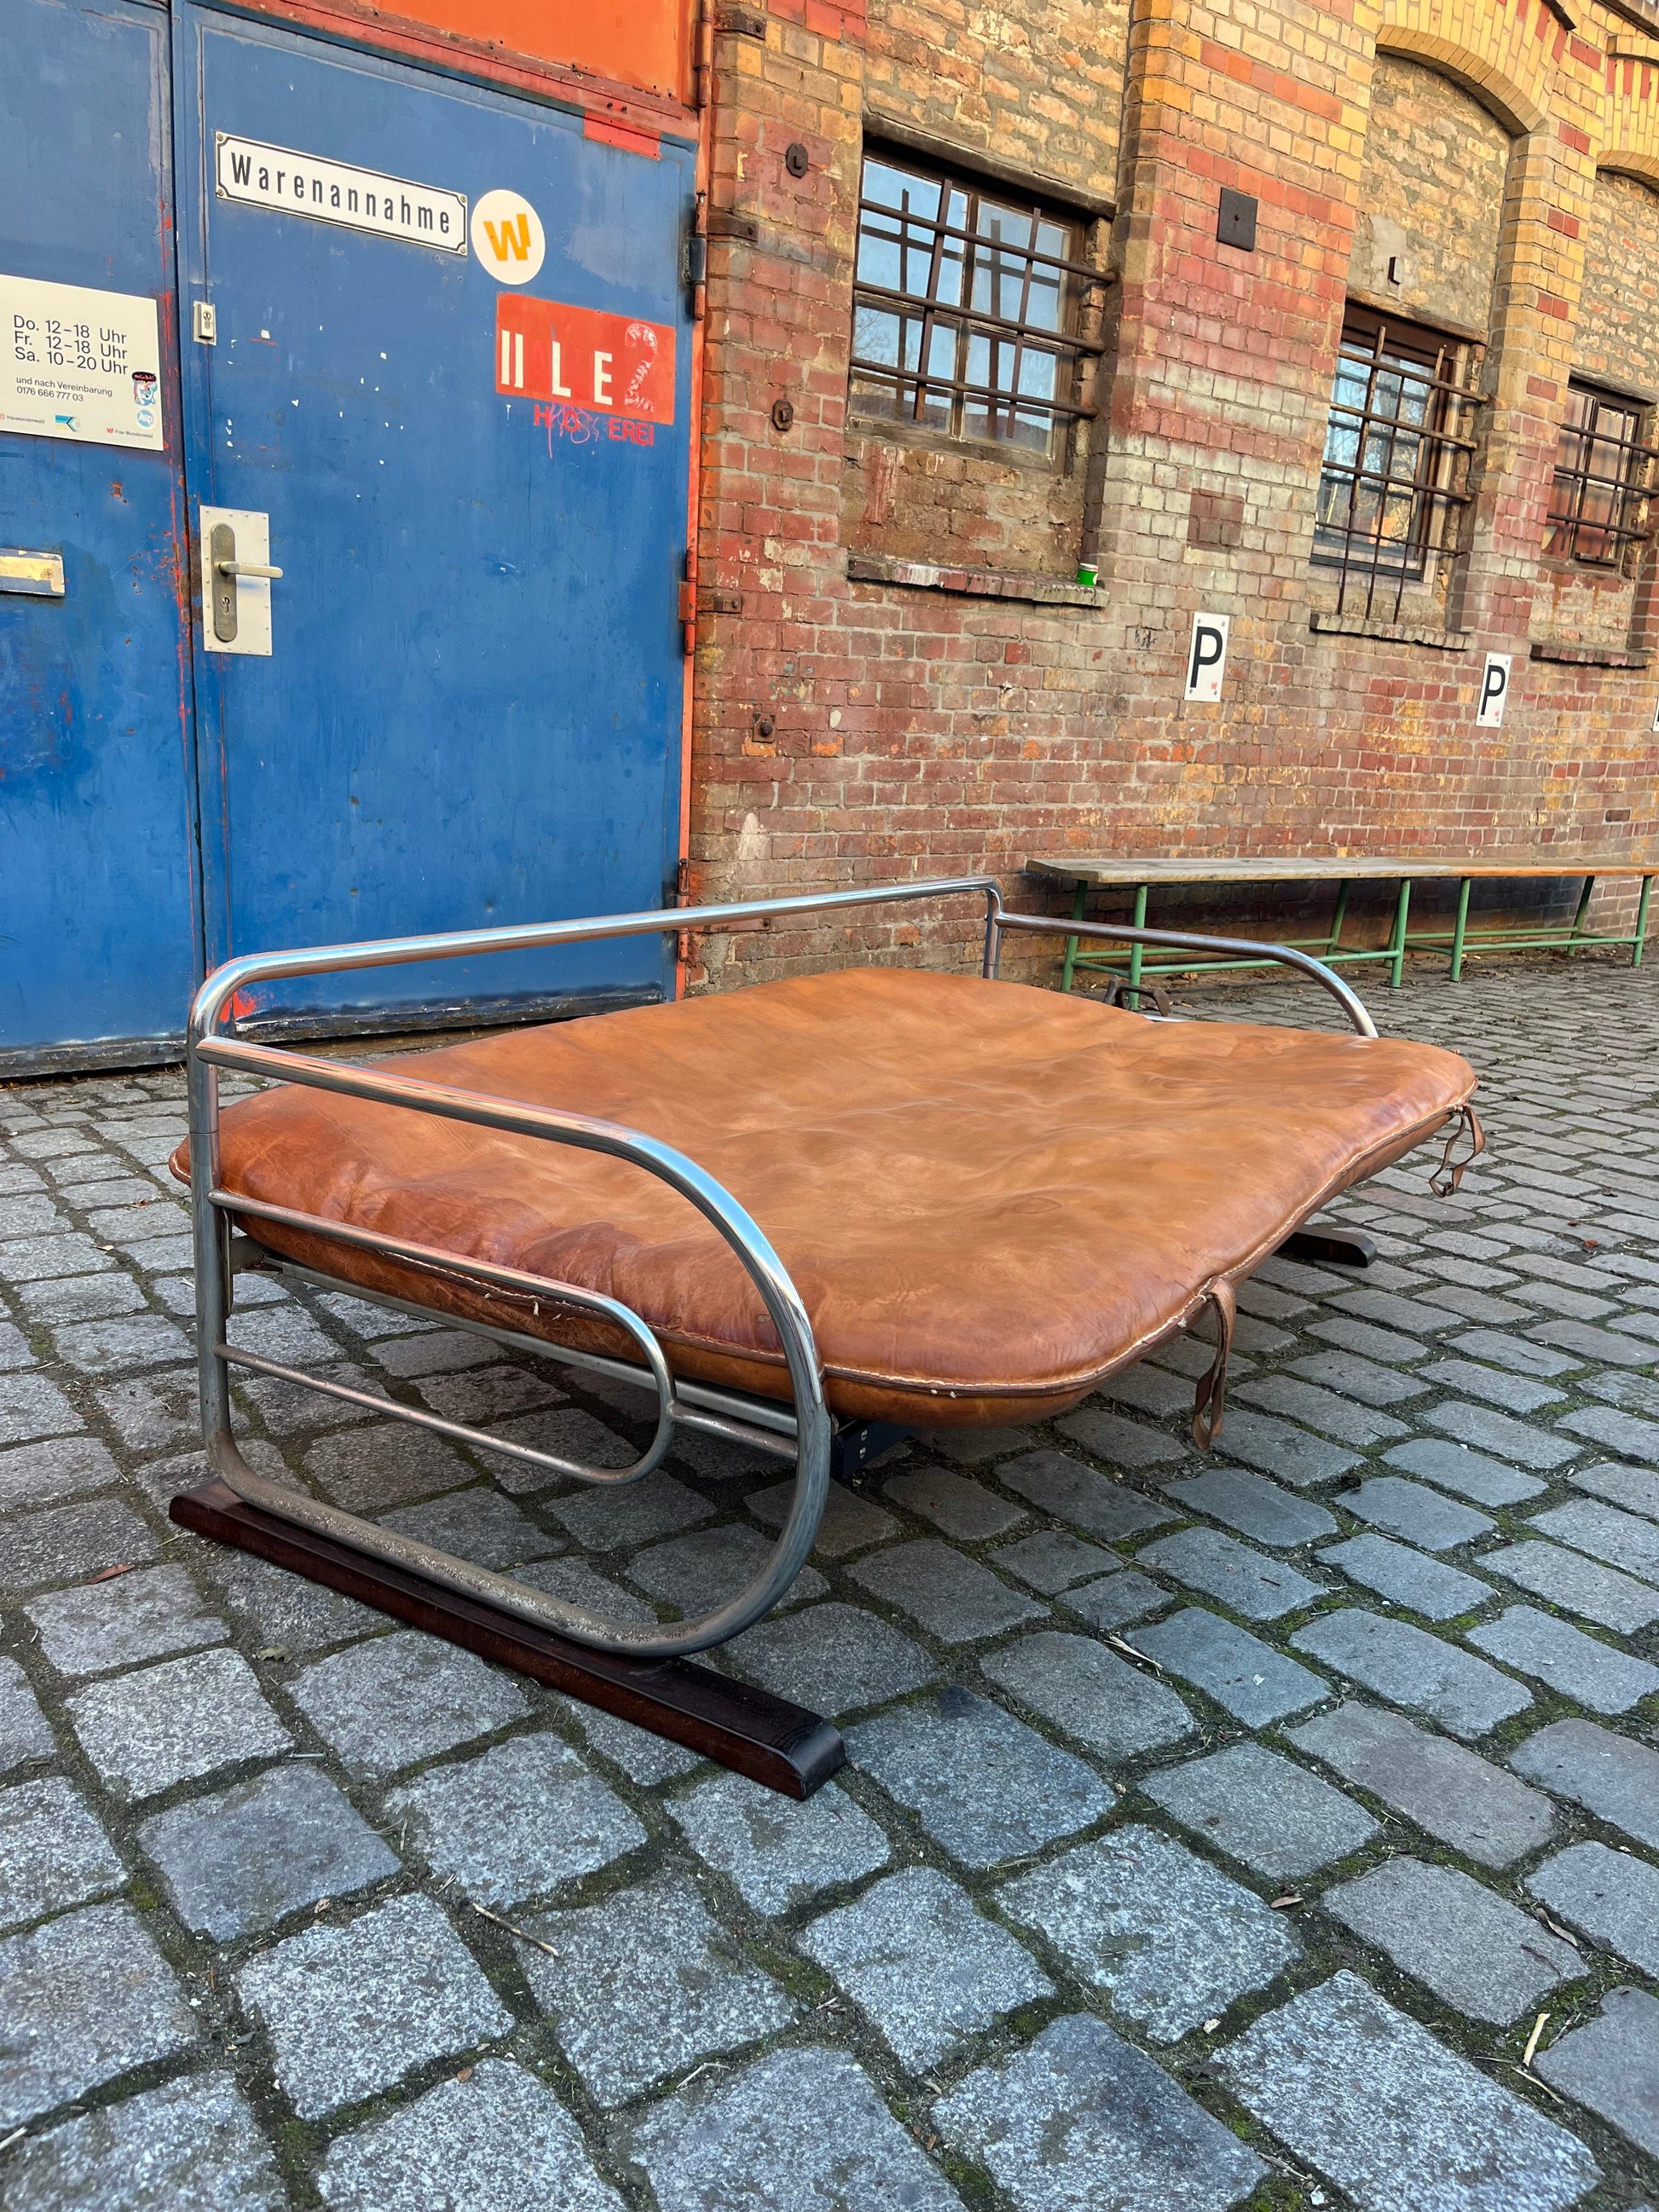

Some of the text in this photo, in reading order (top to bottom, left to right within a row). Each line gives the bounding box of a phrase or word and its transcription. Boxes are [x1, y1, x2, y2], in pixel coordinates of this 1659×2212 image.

[231, 152, 449, 234] Warenannahme
[14, 315, 39, 332] Do.
[100, 327, 126, 344] Uhr
[14, 331, 32, 346] Fr.
[101, 344, 127, 360] Uhr
[15, 346, 39, 362] Sa.
[101, 359, 128, 375] Uhr
[16, 377, 113, 398] und nach Vereinbarung
[16, 386, 36, 396] 0176
[38, 389, 55, 398] 666
[1190, 626, 1223, 688] P
[1481, 664, 1506, 715] P
